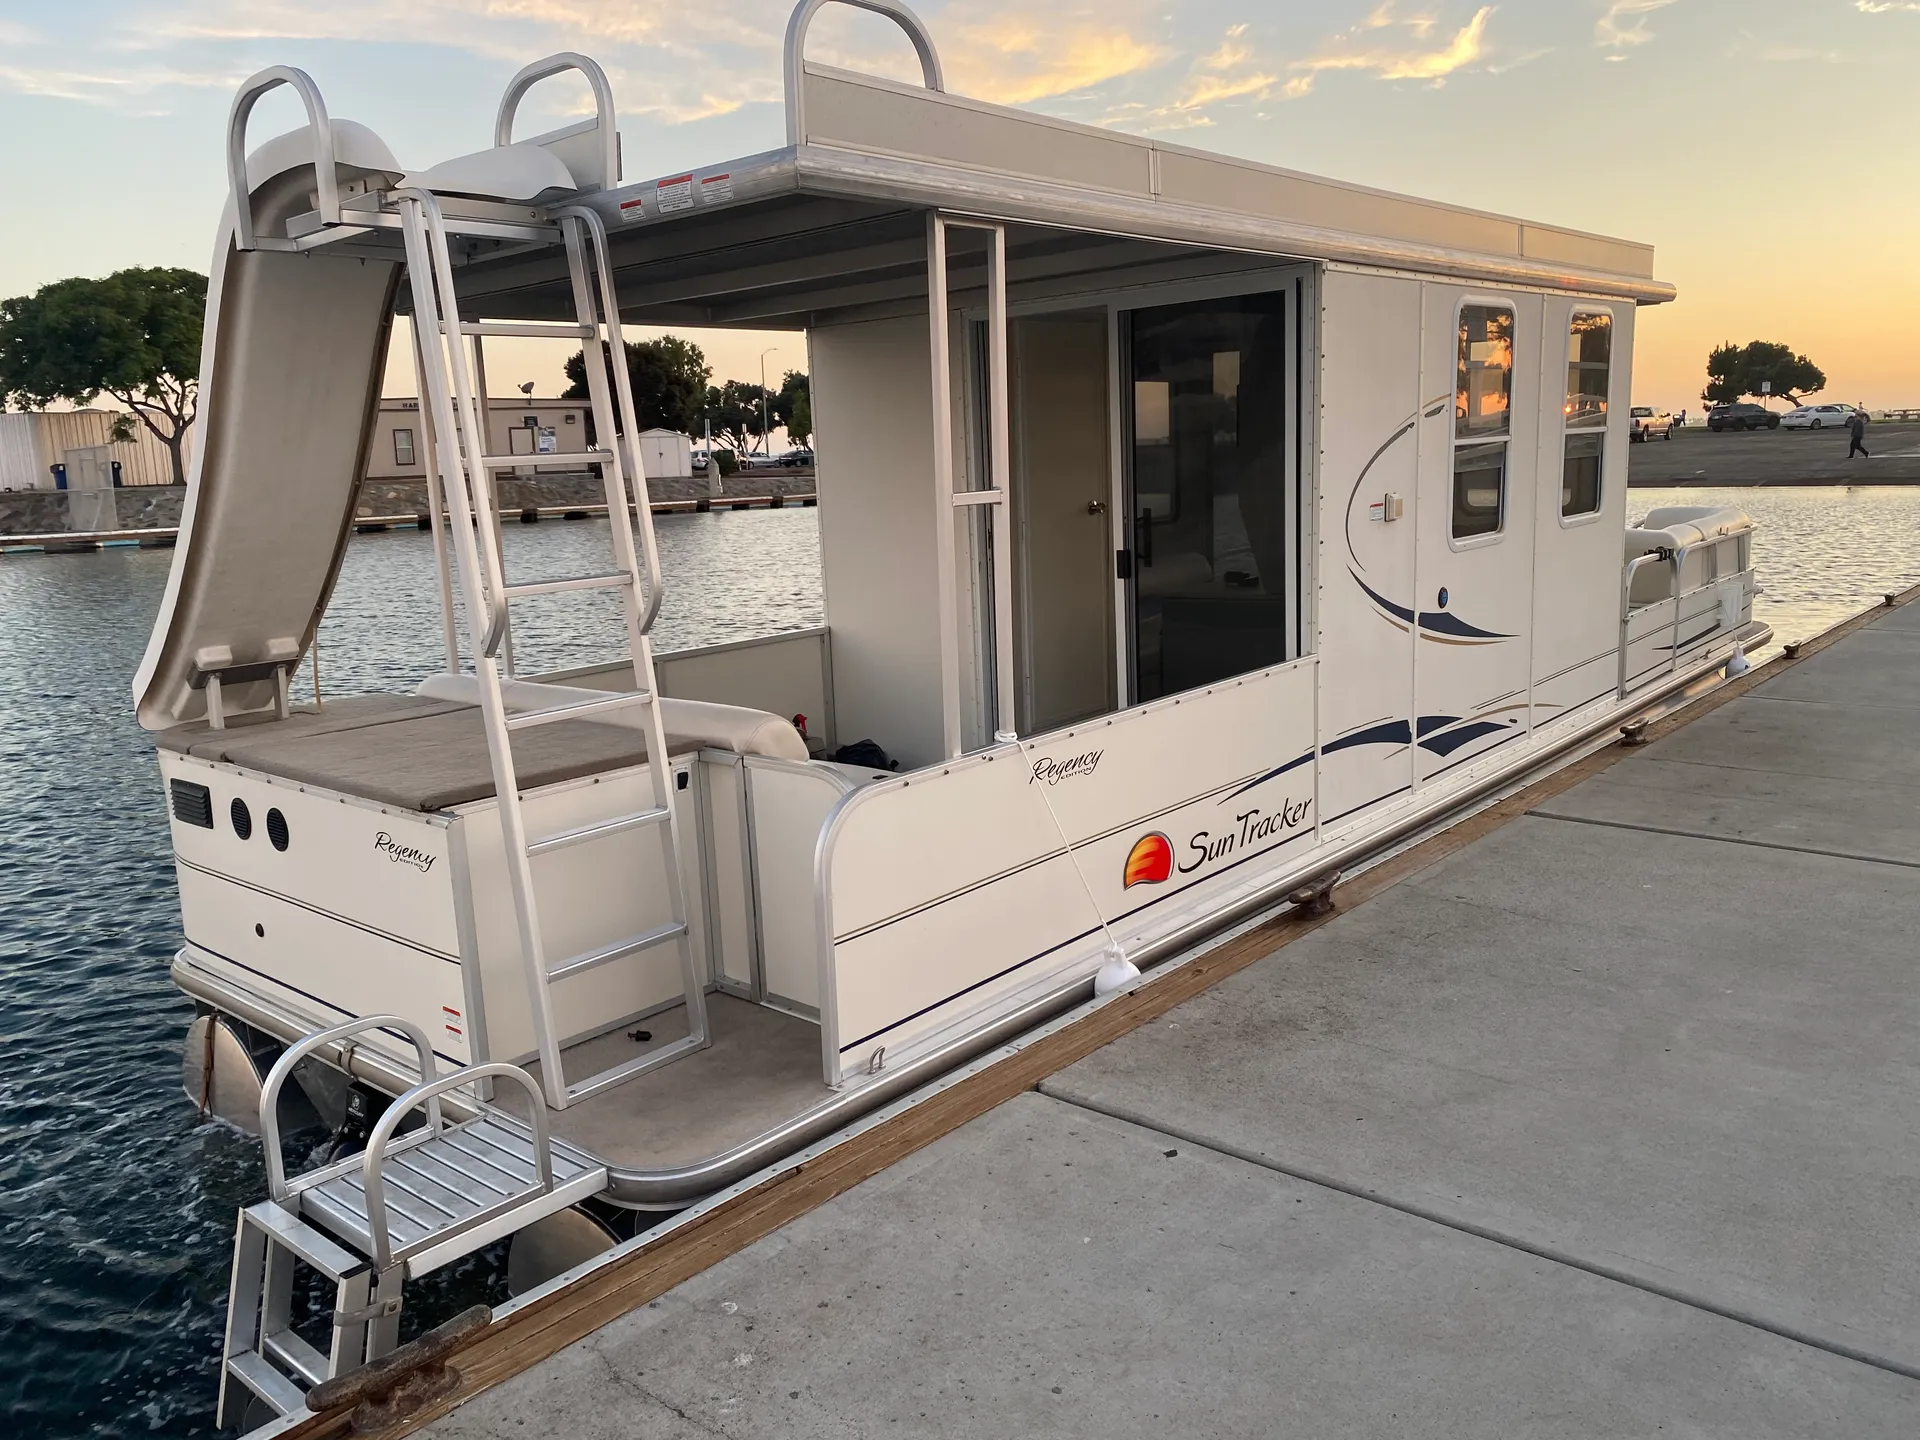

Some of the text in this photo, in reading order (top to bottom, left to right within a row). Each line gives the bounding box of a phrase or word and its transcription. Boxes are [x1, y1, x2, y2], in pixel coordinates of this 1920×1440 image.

[1029, 749, 1105, 786] Regency
[1060, 766, 1092, 780] EDITION
[374, 831, 437, 873] Regency
[1178, 797, 1313, 874] Sun Tracker
